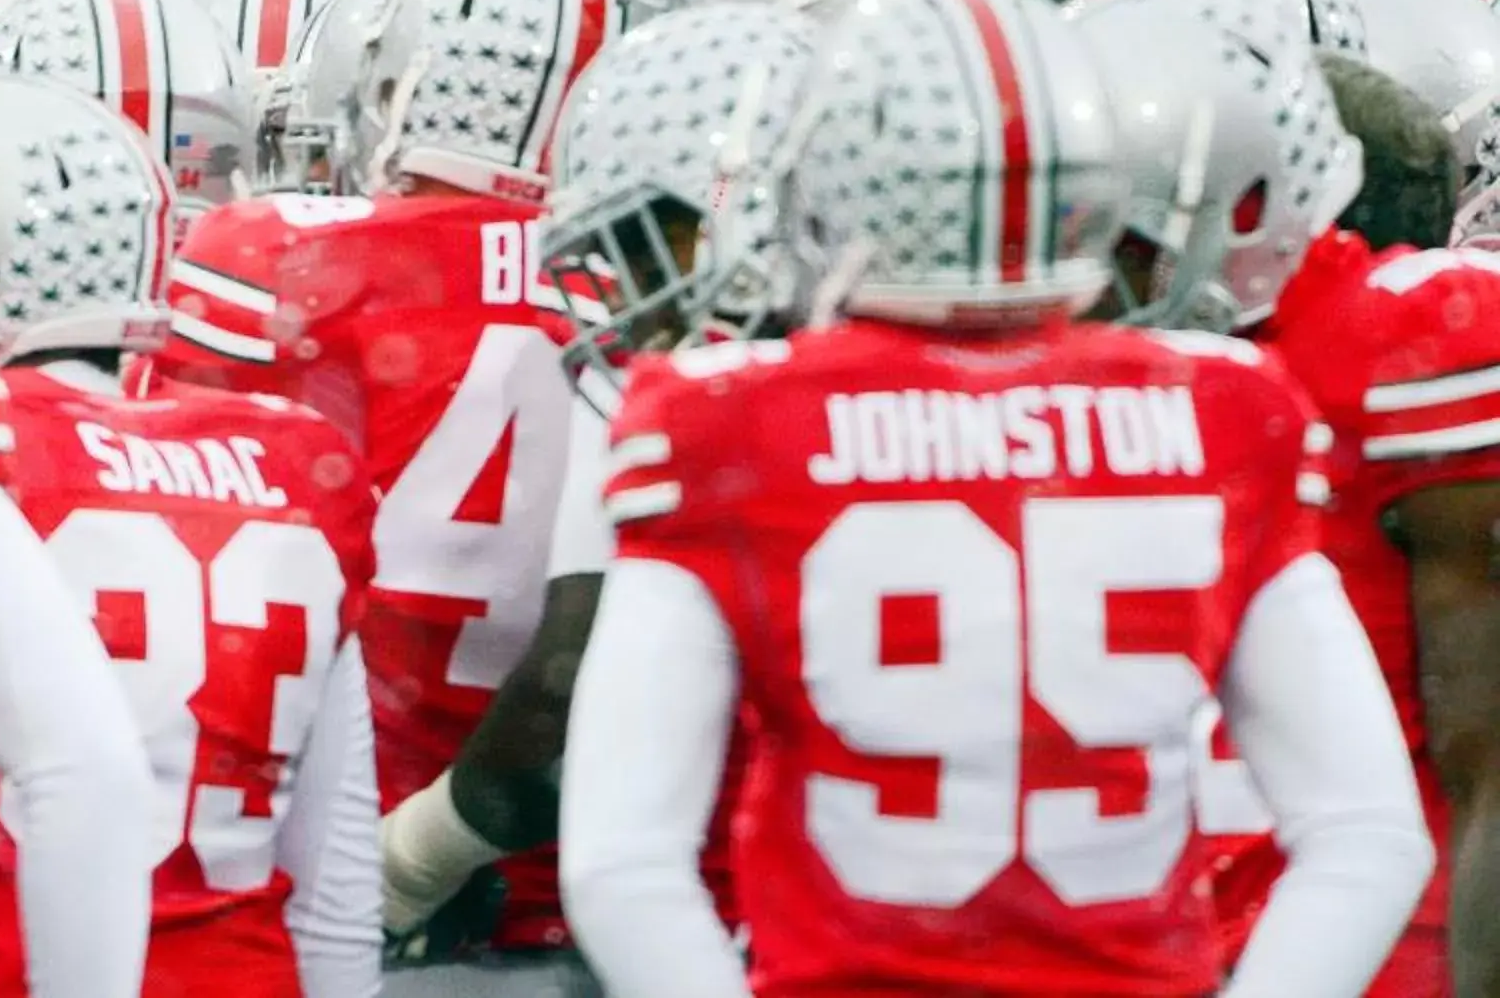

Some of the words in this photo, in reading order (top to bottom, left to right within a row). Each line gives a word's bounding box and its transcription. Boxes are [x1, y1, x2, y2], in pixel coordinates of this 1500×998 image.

[75, 421, 289, 508] SARAC
[808, 385, 1206, 485] JOHNSTON
[799, 496, 1227, 908] 95
